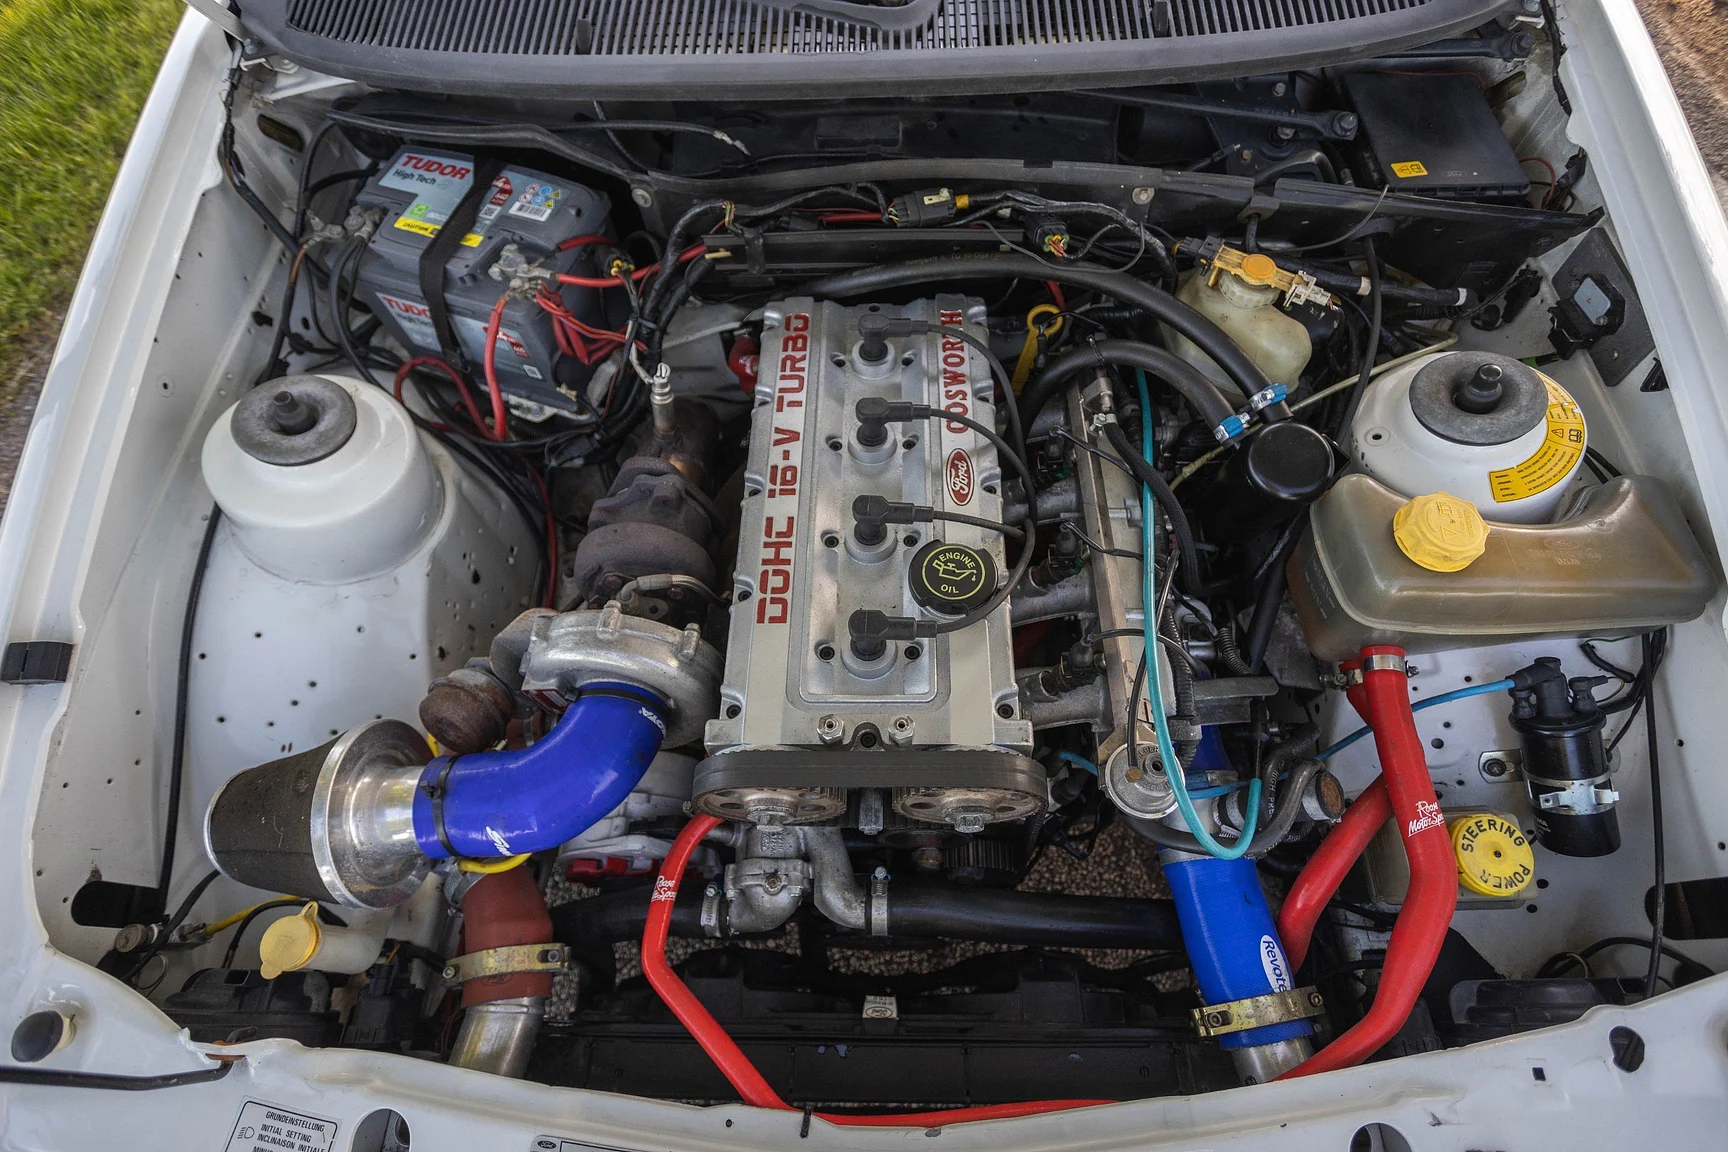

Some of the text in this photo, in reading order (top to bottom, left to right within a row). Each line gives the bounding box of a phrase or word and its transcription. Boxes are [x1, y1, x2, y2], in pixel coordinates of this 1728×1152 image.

[393, 168, 437, 186] High Tech
[401, 154, 471, 180] TUDOR
[941, 309, 969, 434] COSWORH
[756, 313, 811, 624] DOHC 16-V TURBO
[951, 459, 969, 495] Ford
[938, 551, 976, 568] ENGINE
[940, 584, 959, 594] OIL
[1269, 769, 1279, 792] HIGH
[1408, 812, 1445, 838] MotorSpo
[1461, 818, 1525, 853] STEERING
[1479, 863, 1531, 890] POWER
[1262, 939, 1288, 993] Revote
[261, 1123, 312, 1143] INITIAL SETTING
[266, 1111, 325, 1132] GRUNDEINSTELLUNG
[257, 1133, 296, 1150] INCLINAISON
